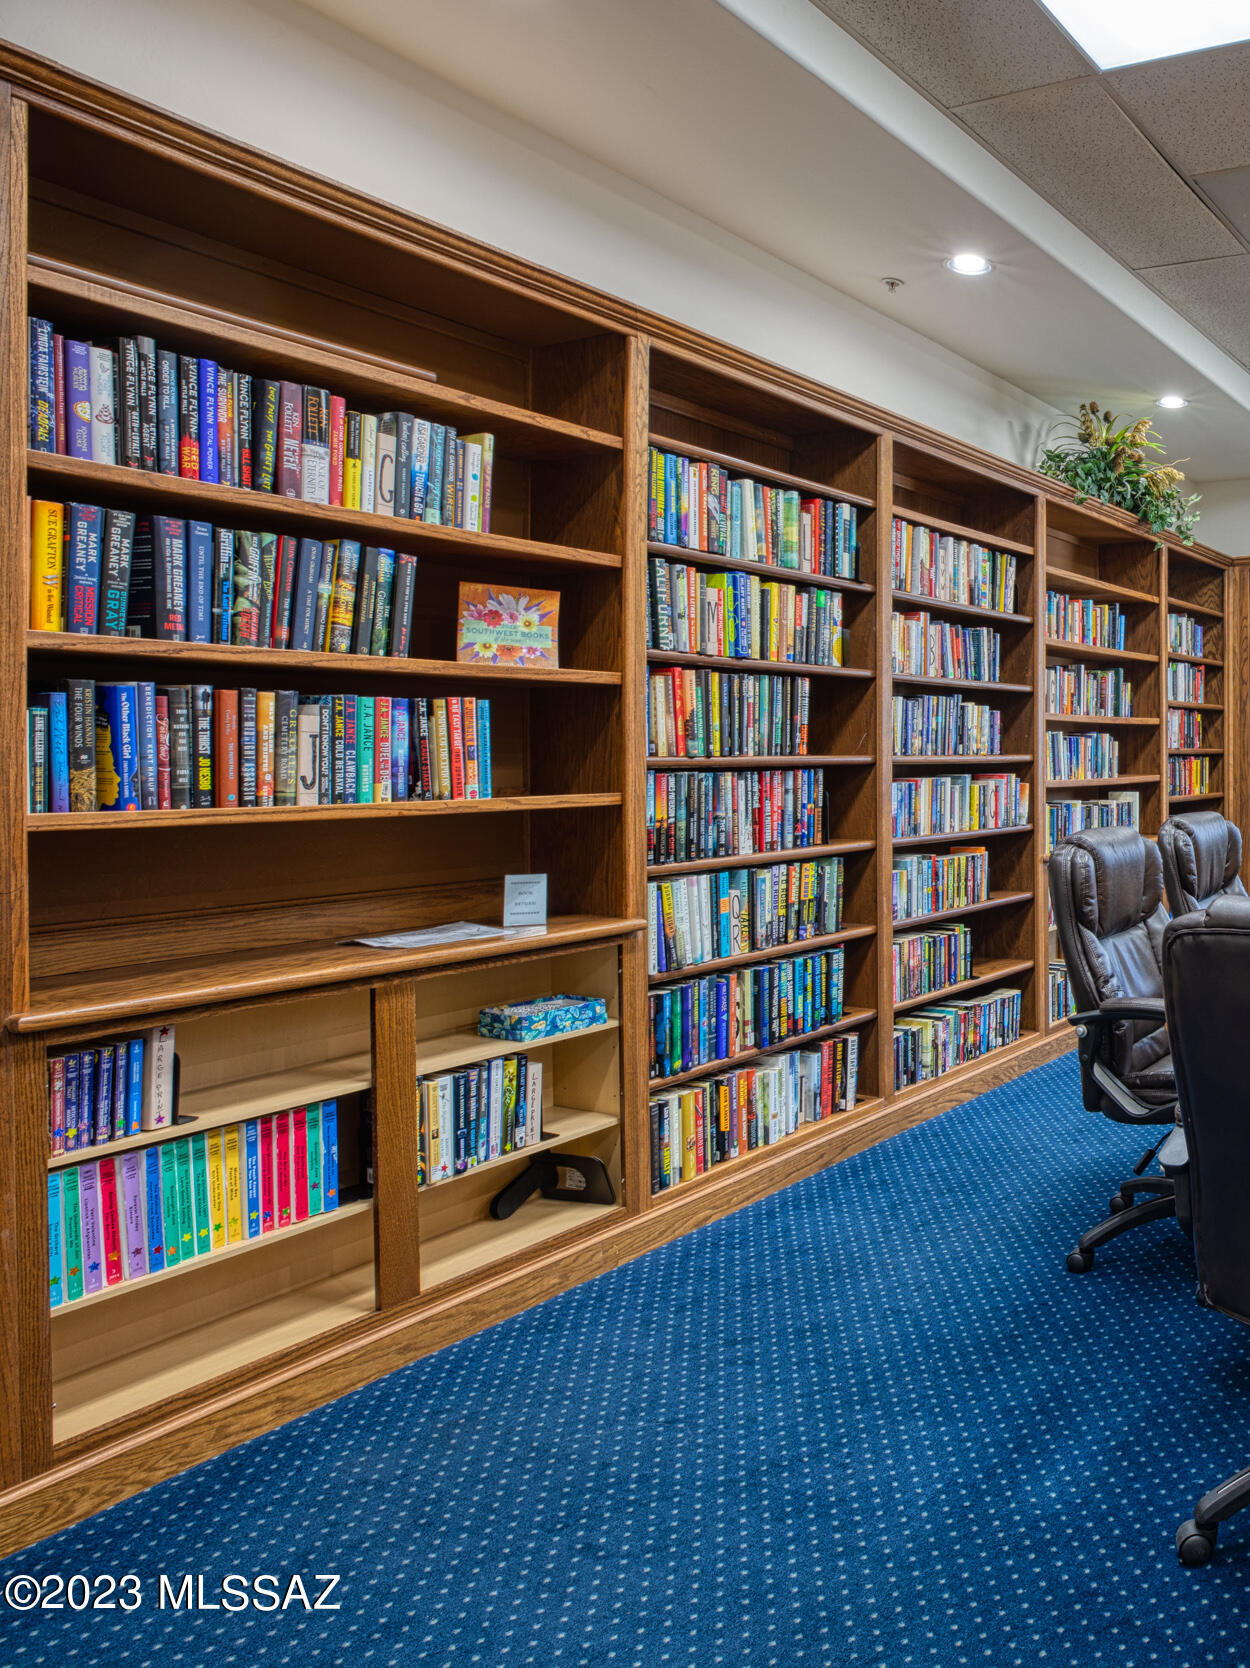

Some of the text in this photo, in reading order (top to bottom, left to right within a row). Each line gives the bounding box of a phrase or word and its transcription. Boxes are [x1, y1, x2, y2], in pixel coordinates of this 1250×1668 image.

[37, 328, 48, 392] LINDA FAIRSTEIN
[126, 345, 134, 405] VINCE FLYNN
[148, 354, 156, 382] VINCE
[148, 384, 156, 415] FLYNN
[162, 386, 169, 394] TO
[189, 365, 198, 433] VINCE FLYNN
[217, 372, 227, 422] THE SURVIVOR
[37, 400, 49, 442] DEADFALL
[240, 378, 249, 439] VINCE FLYNN
[284, 402, 293, 434] FOLLETT
[307, 396, 318, 434] FOLLETT
[319, 408, 328, 428] KEN
[182, 446, 190, 469] WAR
[191, 447, 199, 470] RED
[264, 443, 273, 472] GUEST
[283, 438, 299, 471] NEVER
[416, 423, 426, 464] LISA GARDNER
[242, 449, 251, 487] KILL SHOT
[262, 474, 271, 490] LIST
[306, 460, 317, 495] ETERNITY
[415, 472, 425, 497] TOUCH
[711, 468, 719, 496] KING
[414, 502, 422, 514] GO
[446, 484, 454, 521] WIRED
[46, 509, 57, 570] SUE GRAFTON
[76, 521, 87, 571] GREANEY
[87, 533, 97, 563] MARK
[108, 527, 120, 576] GREANEY
[120, 538, 130, 568] MARK
[220, 532, 232, 562] Griffin
[172, 538, 183, 612] MARK GREANEY
[248, 547, 259, 581] GRIFFIN
[285, 540, 296, 592] JOHN GRISHAM
[343, 545, 352, 575] GRISHAM
[378, 554, 386, 583] GRISHAM
[74, 585, 84, 624] CRITICAL
[84, 586, 94, 626] MISSION
[105, 590, 119, 630] GRAY
[118, 591, 127, 630] GUNMETAL
[198, 596, 204, 604] OF
[376, 591, 386, 629] GUARDIANS
[240, 612, 250, 638] DEATH
[281, 610, 289, 640] WHISTLER
[466, 627, 549, 639] SOUTHWEST BOOKS
[74, 688, 83, 748] THE FOUR WINDS
[84, 688, 92, 714] KRISTIN
[121, 701, 129, 722] Other
[280, 716, 288, 756] CEMETERY
[336, 699, 344, 795] J.A. JANCE COLD BETRAYAL
[345, 700, 355, 794] J.A. JANCE CLAWBACK
[380, 702, 389, 761] J.A. JANCE DUEL
[397, 720, 406, 741] JANCE
[419, 701, 430, 791] J.A. JANCE DEADLY STAKES
[848, 1057, 856, 1080] TAYLOR
